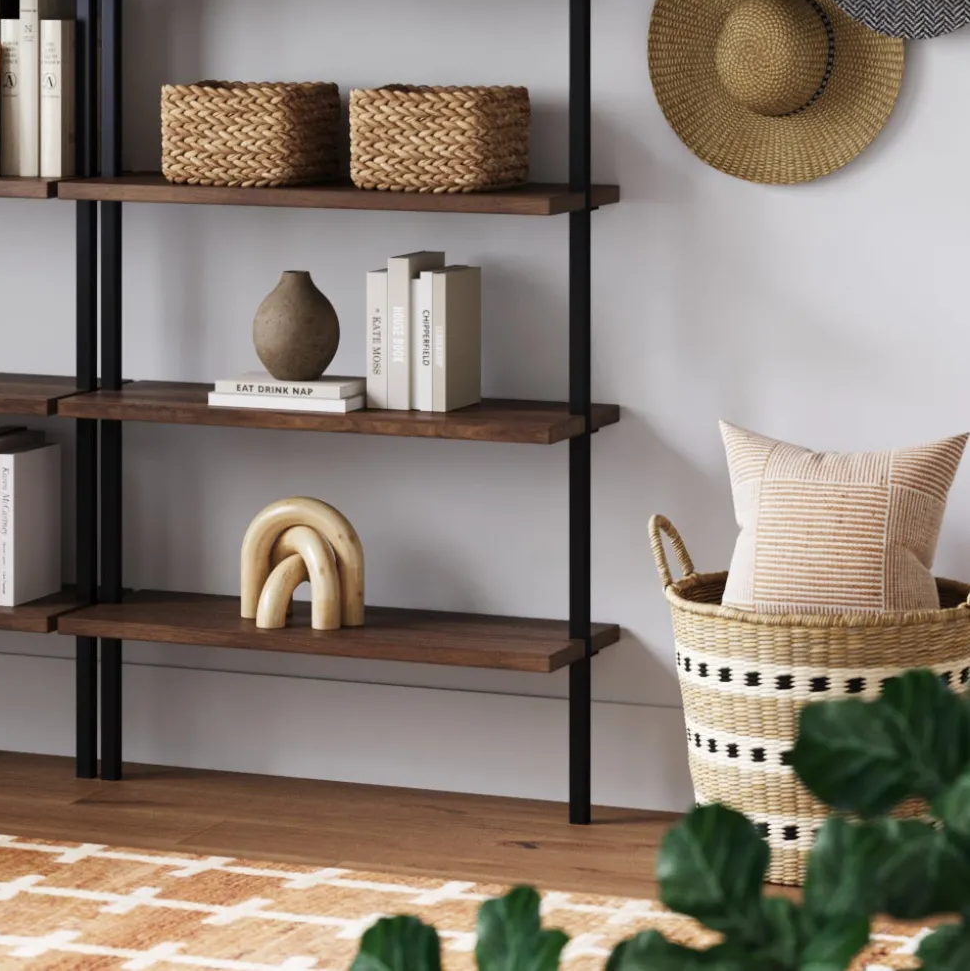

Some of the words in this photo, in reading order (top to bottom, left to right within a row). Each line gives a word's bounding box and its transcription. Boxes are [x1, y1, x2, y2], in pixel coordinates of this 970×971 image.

[372, 316, 381, 344] KATE
[392, 306, 404, 335] HOUSE
[392, 338, 404, 363] BOOK
[422, 309, 430, 366] CHIPPERFIELD
[373, 347, 382, 375] MOSS
[236, 384, 254, 392] EAT
[258, 385, 289, 395] DRINK
[292, 387, 314, 396] NAP
[1, 466, 10, 490] Karen
